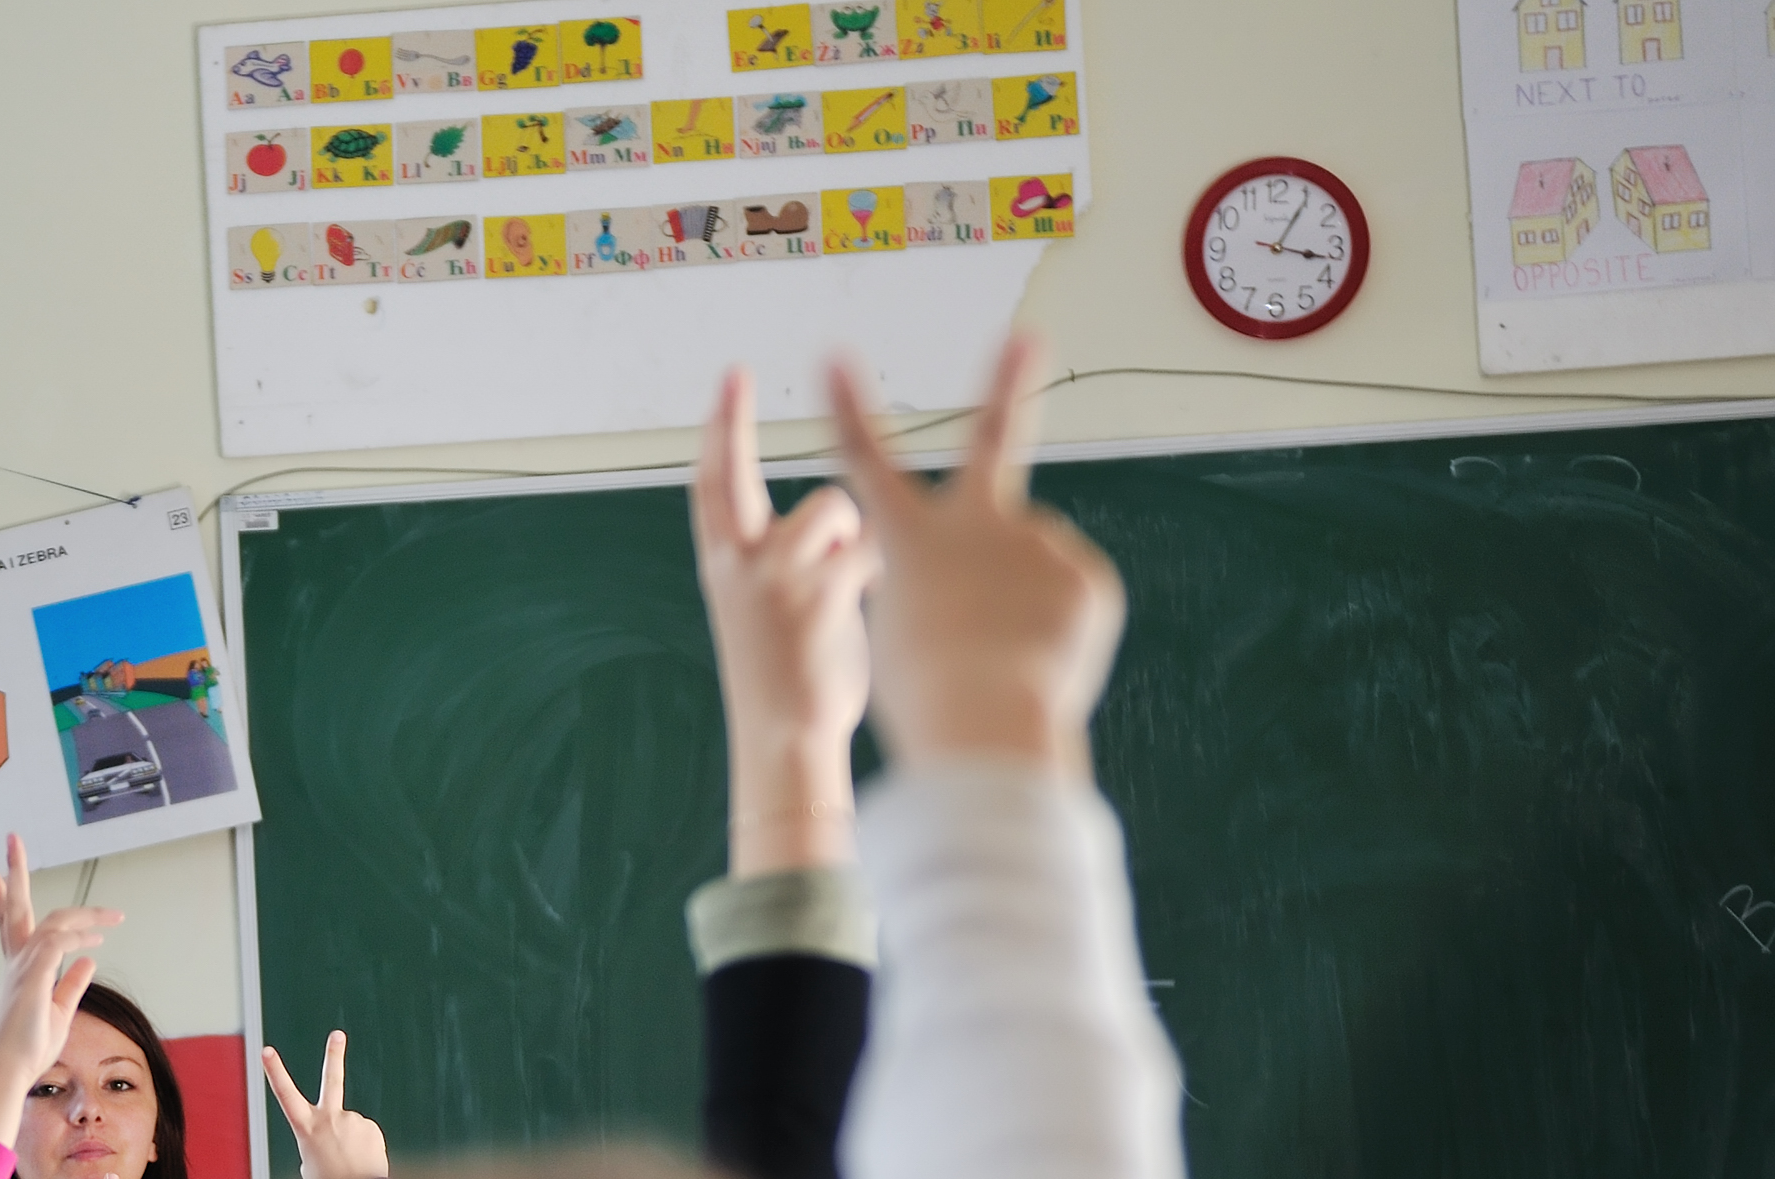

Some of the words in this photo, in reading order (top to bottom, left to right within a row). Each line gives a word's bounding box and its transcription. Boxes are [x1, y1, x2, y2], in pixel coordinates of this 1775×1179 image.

[396, 73, 422, 88] Vv
[479, 69, 507, 89] Gg
[564, 62, 591, 79] Dd
[230, 90, 255, 106] Aa
[314, 83, 340, 99] Bb
[1515, 77, 1597, 106] NEXT
[911, 123, 936, 144] Pp
[570, 149, 606, 165] Mm
[316, 167, 344, 183] Kk
[401, 162, 422, 179] Ll
[228, 173, 247, 193] Jj
[1265, 179, 1289, 204] 12
[1240, 186, 1257, 211] 11
[1215, 206, 1240, 231] 10
[1320, 203, 1337, 228] 2
[658, 246, 686, 263] Hh
[1209, 237, 1225, 262] 9
[1327, 235, 1344, 260] 3
[573, 252, 596, 269] Ff
[231, 269, 254, 285] Ss
[315, 264, 336, 280] Tt
[1218, 266, 1237, 292] 8
[1316, 264, 1335, 289] 4
[1513, 253, 1654, 292] OPPOSITE
[1242, 286, 1257, 311] 7
[1266, 293, 1285, 318] 6
[1297, 285, 1315, 310] 5
[171, 512, 189, 526] 23
[9, 557, 14, 568] I
[17, 545, 68, 567] ZEBRA
